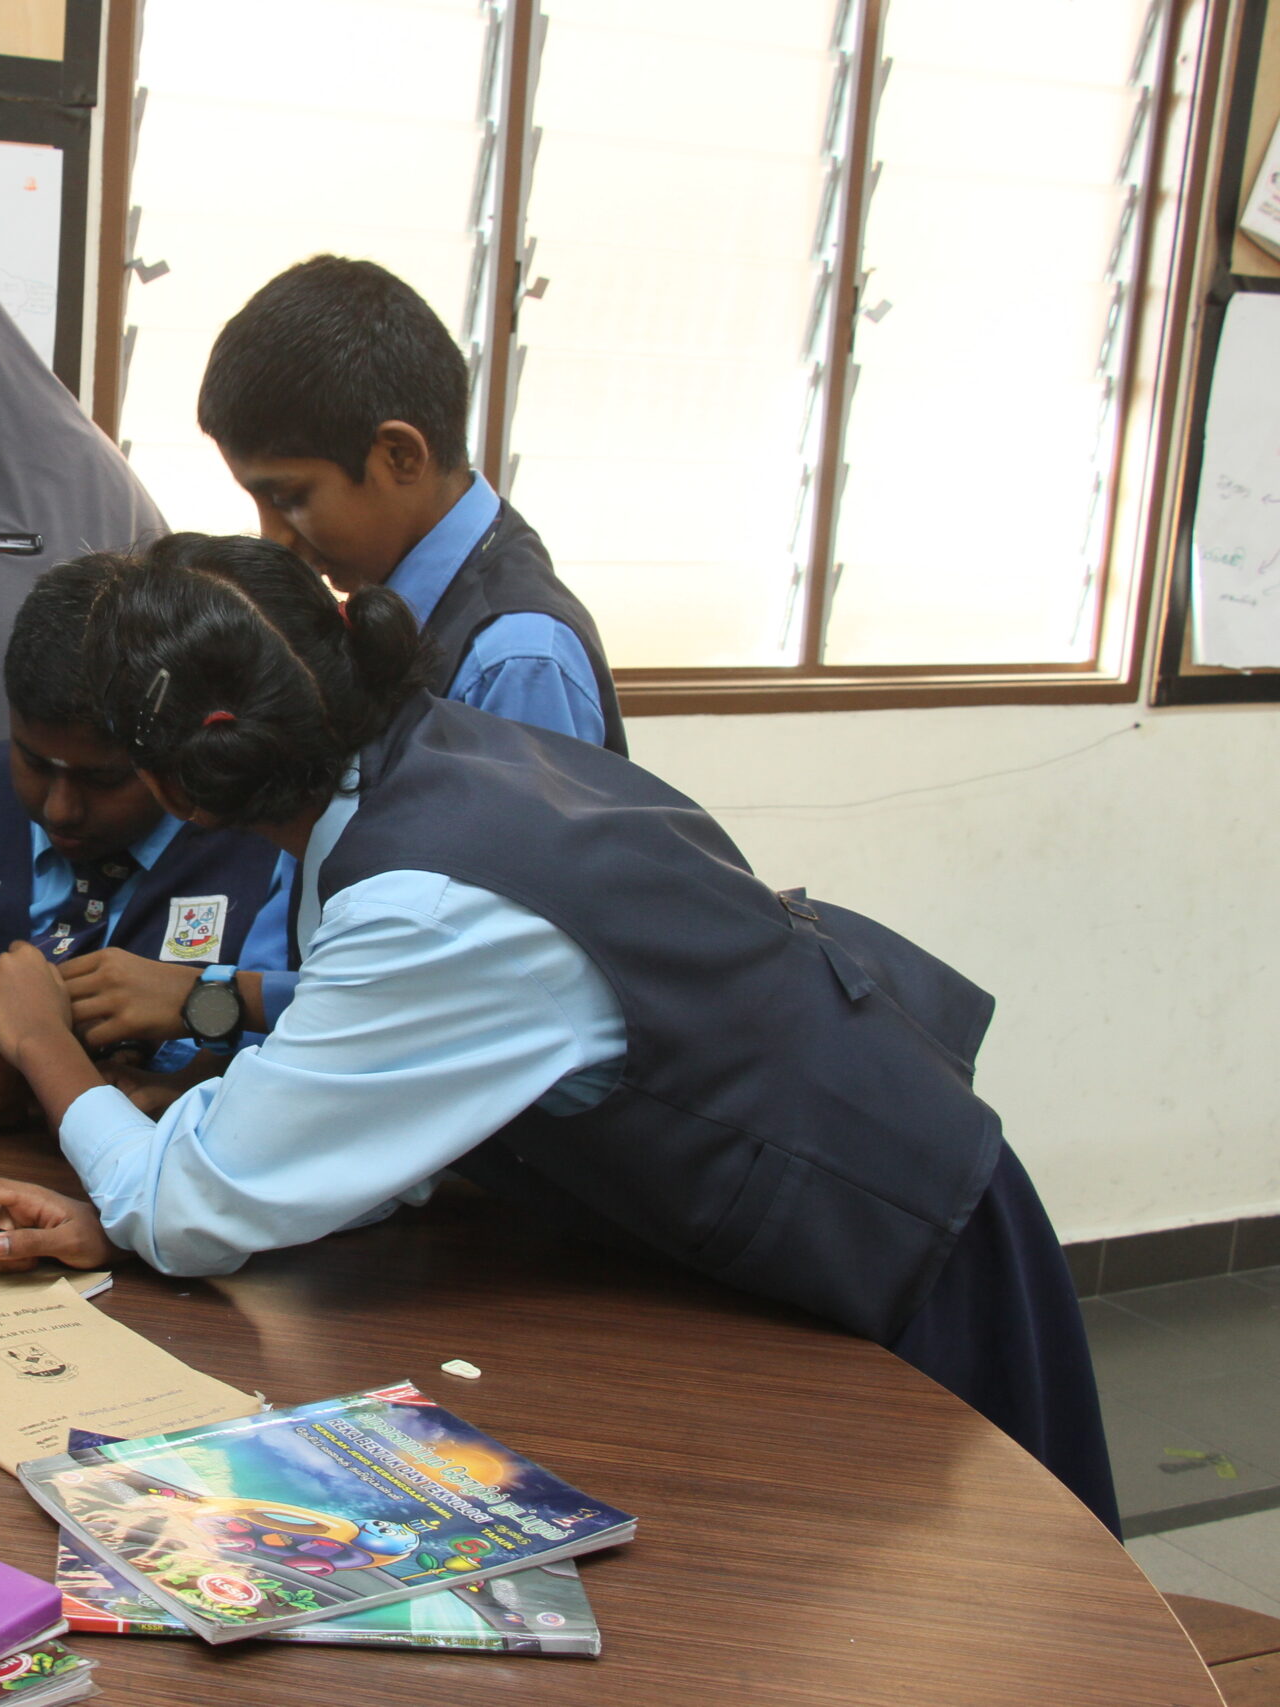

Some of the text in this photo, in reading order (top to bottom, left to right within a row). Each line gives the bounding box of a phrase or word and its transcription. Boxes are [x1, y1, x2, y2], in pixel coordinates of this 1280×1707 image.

[312, 1423, 455, 1520] SEKOLAH JENIS KEBANGSAAN TAMIL
[326, 1418, 494, 1524] REKA BENTUK DAN TEKNOLOGI
[455, 1539, 492, 1555] 5
[481, 1528, 516, 1550] TAHUN
[211, 1579, 249, 1600] KSSR
[140, 1624, 163, 1632] KSSR
